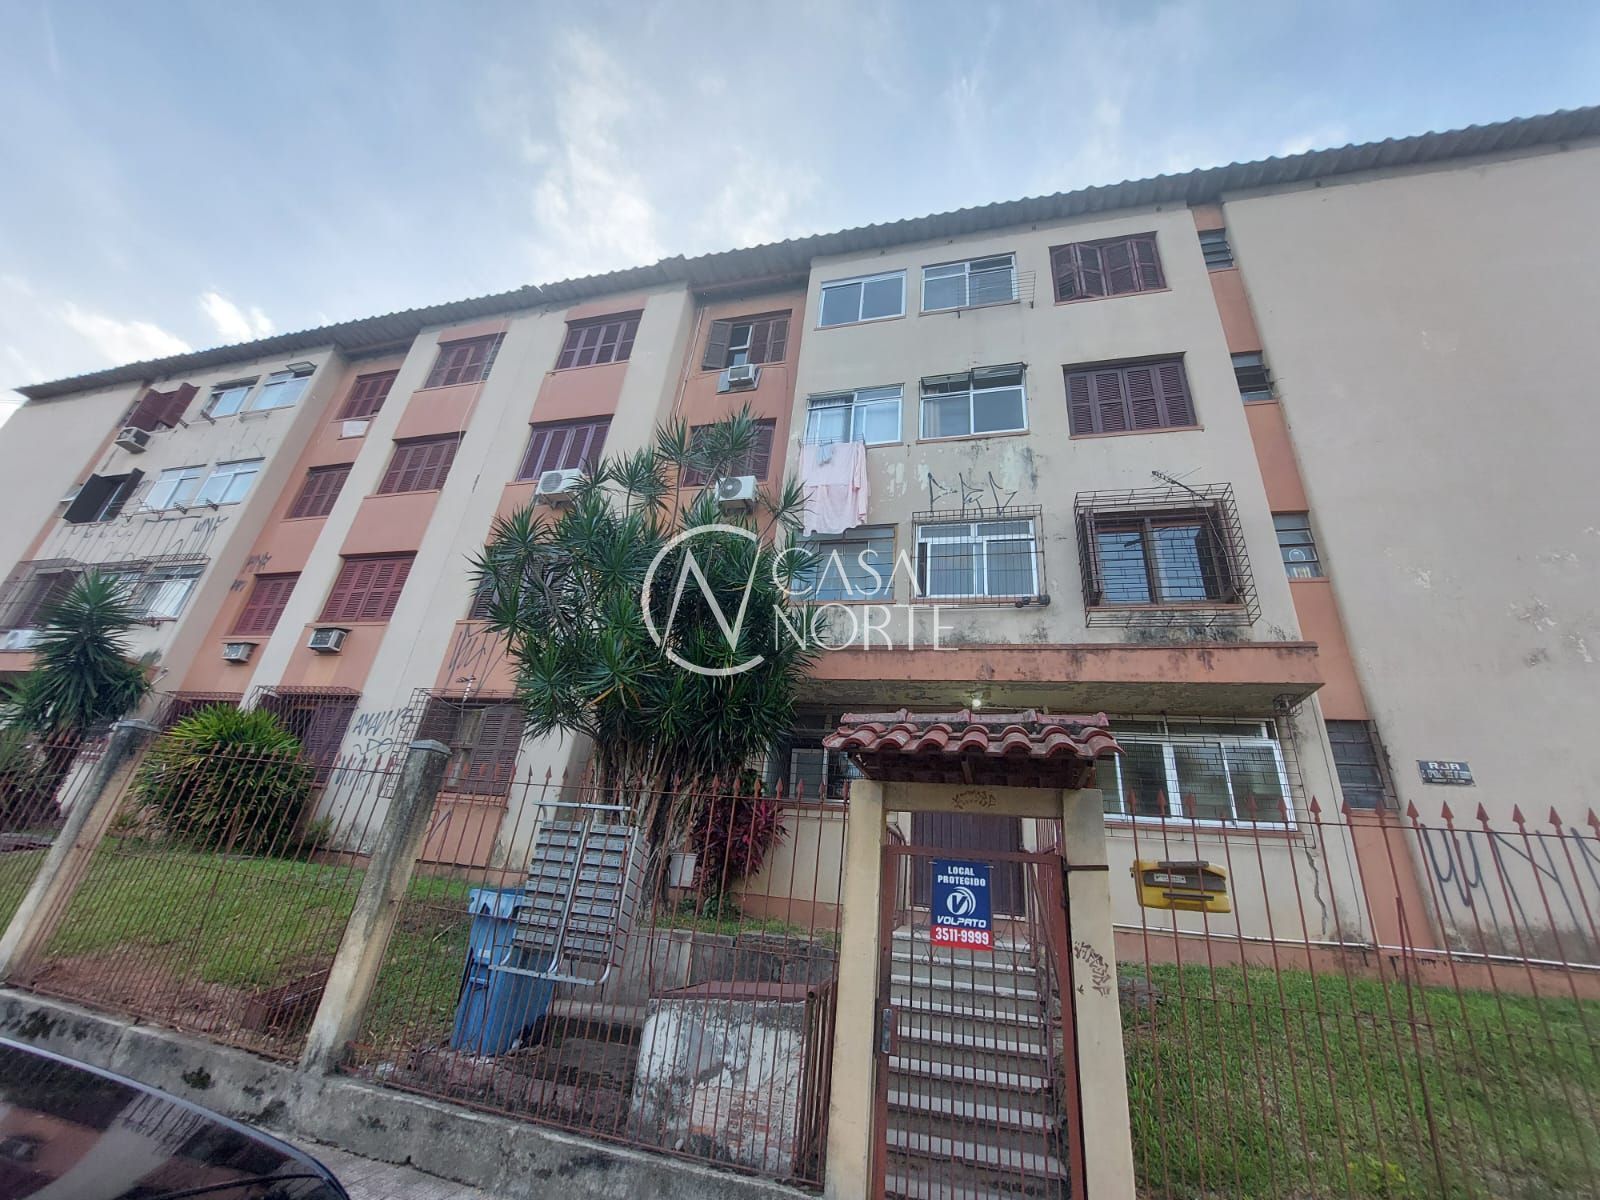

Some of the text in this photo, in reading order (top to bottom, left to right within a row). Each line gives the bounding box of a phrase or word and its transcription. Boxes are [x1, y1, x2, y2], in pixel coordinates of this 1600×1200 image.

[948, 866, 975, 876] LOCAL
[937, 875, 986, 887] PROTEGIDO
[937, 915, 987, 928] VOLPATO
[935, 927, 989, 945] 3511-9999
